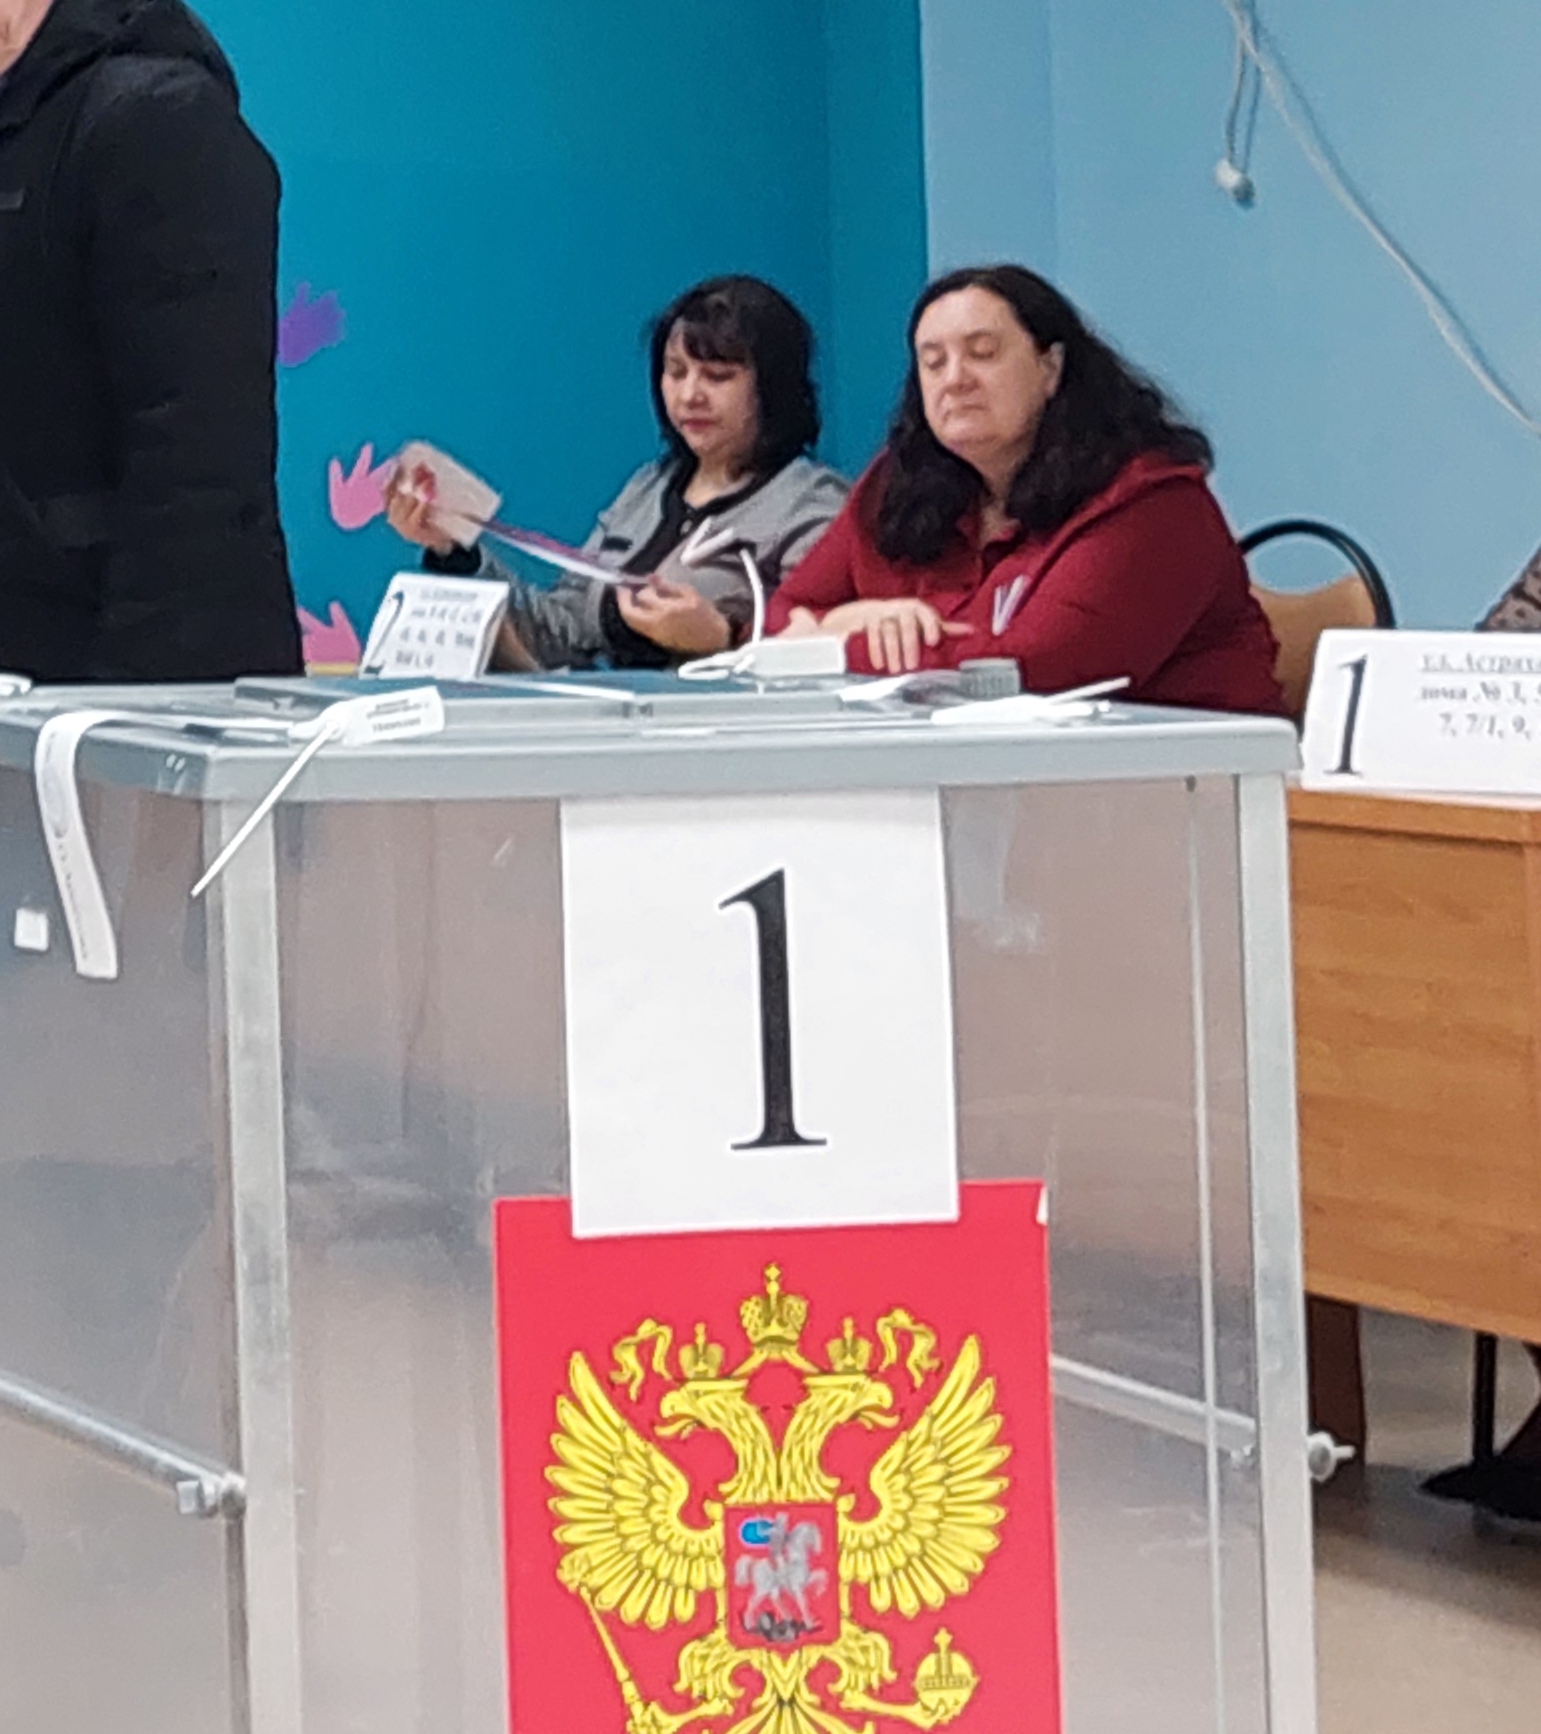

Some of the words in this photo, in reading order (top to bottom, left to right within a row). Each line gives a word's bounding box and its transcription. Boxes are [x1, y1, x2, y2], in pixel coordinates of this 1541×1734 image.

[1323, 652, 1369, 777] 1
[1465, 651, 1541, 675] Астрах
[718, 867, 828, 1150] 1
